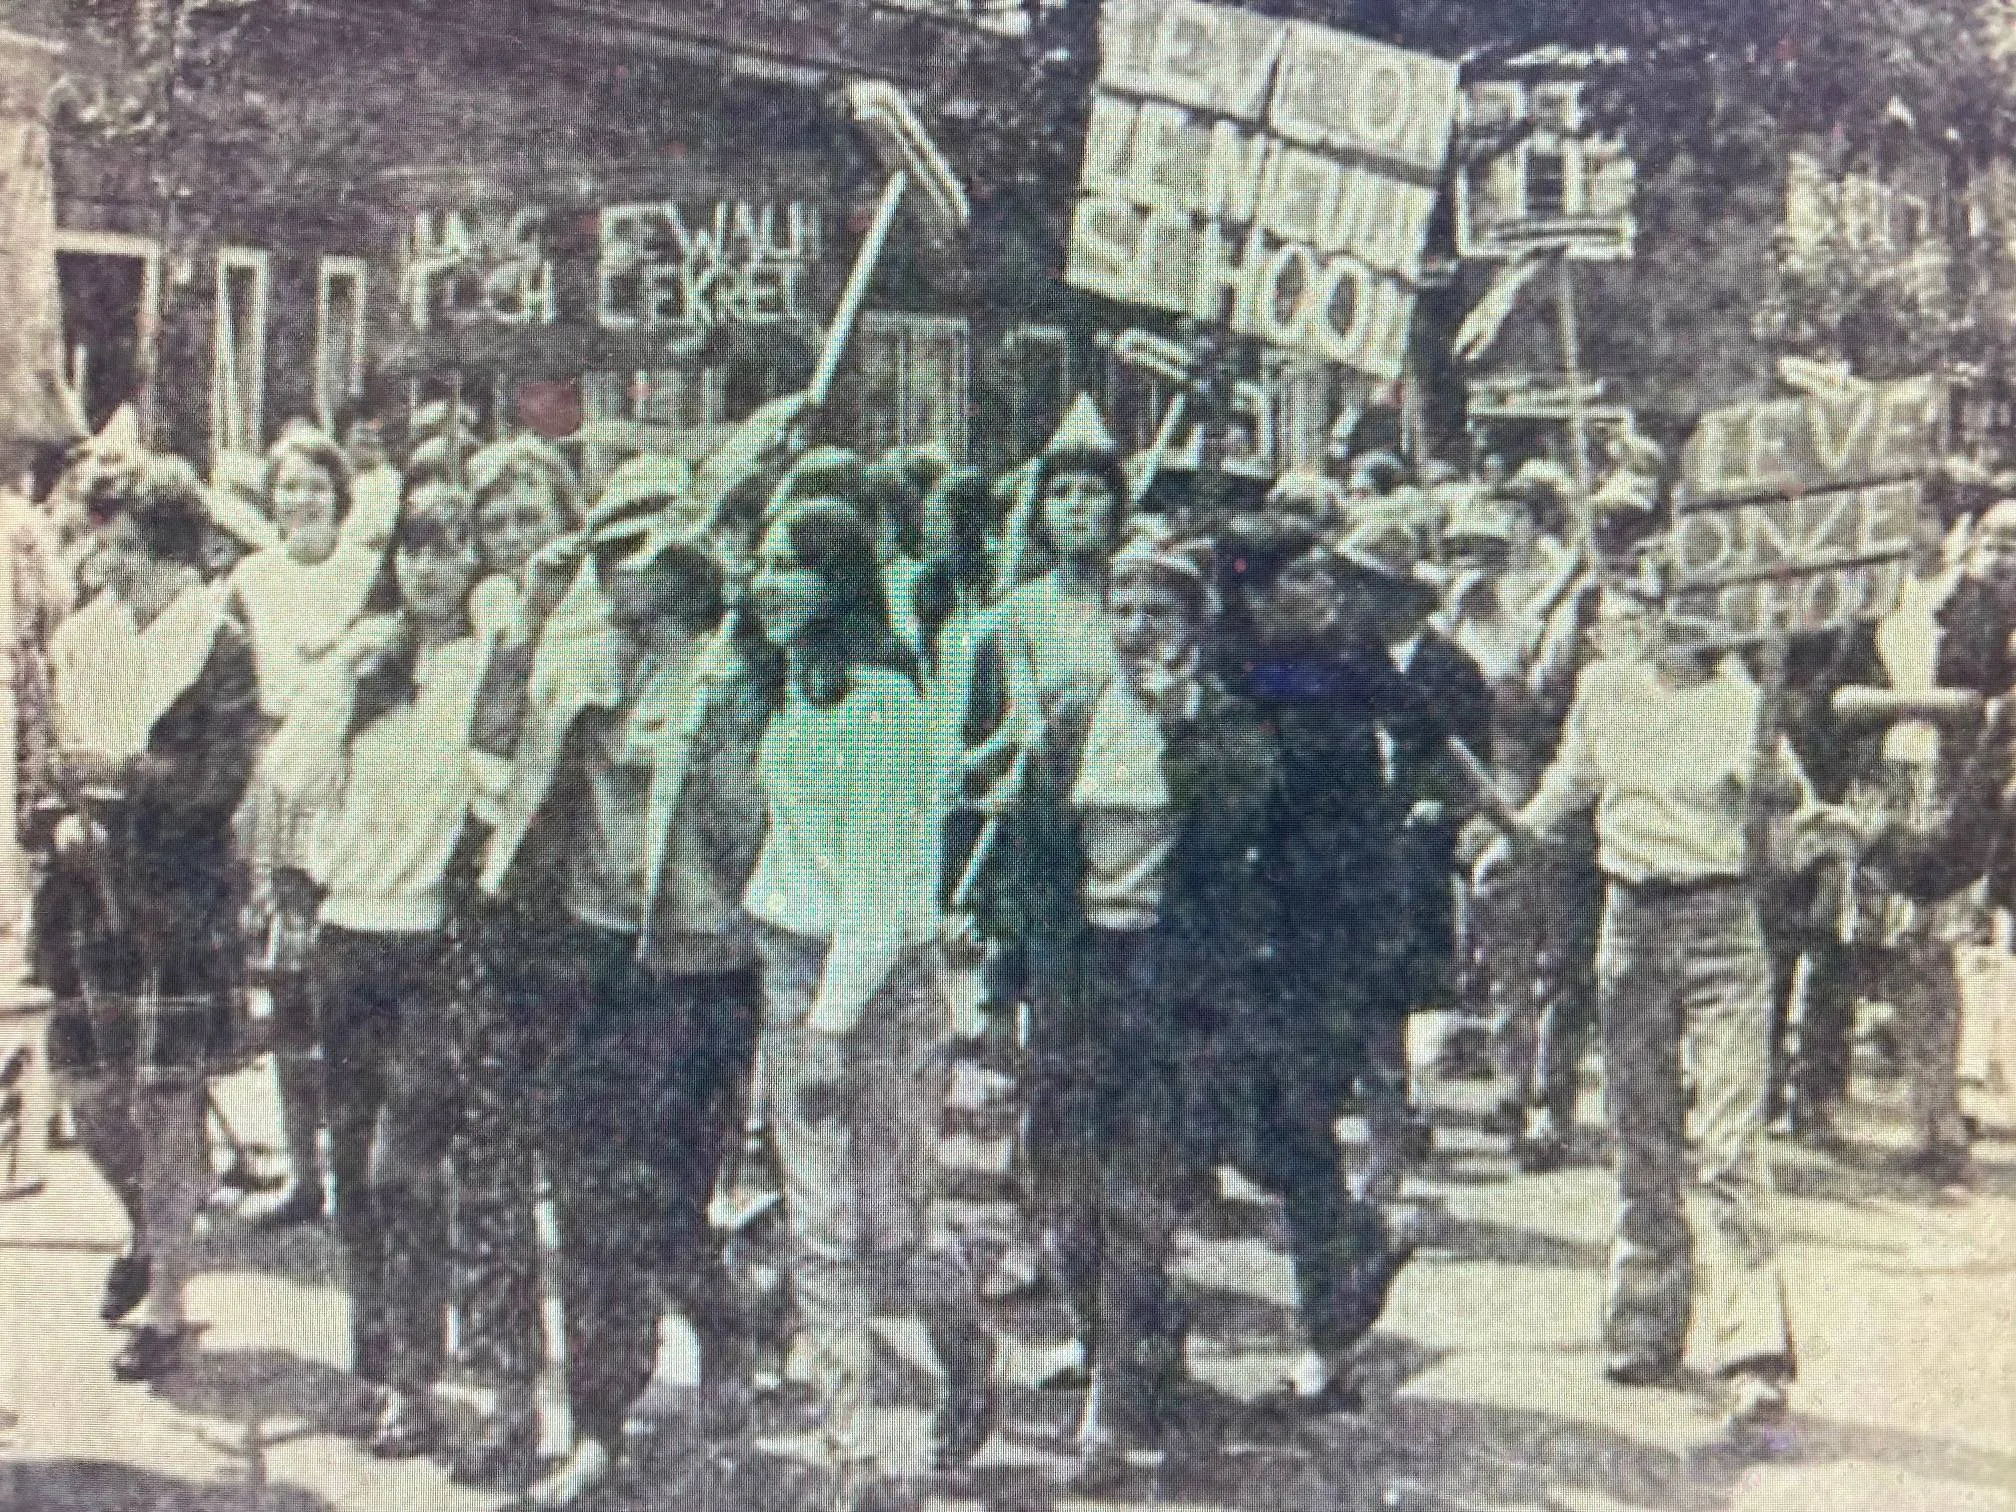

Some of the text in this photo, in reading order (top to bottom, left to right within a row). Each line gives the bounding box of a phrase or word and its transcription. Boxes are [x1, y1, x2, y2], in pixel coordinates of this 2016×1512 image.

[1068, 197, 1404, 377] SCHOOL
[1698, 382, 1928, 491] LEVE
[1672, 484, 1912, 574] ONZE
